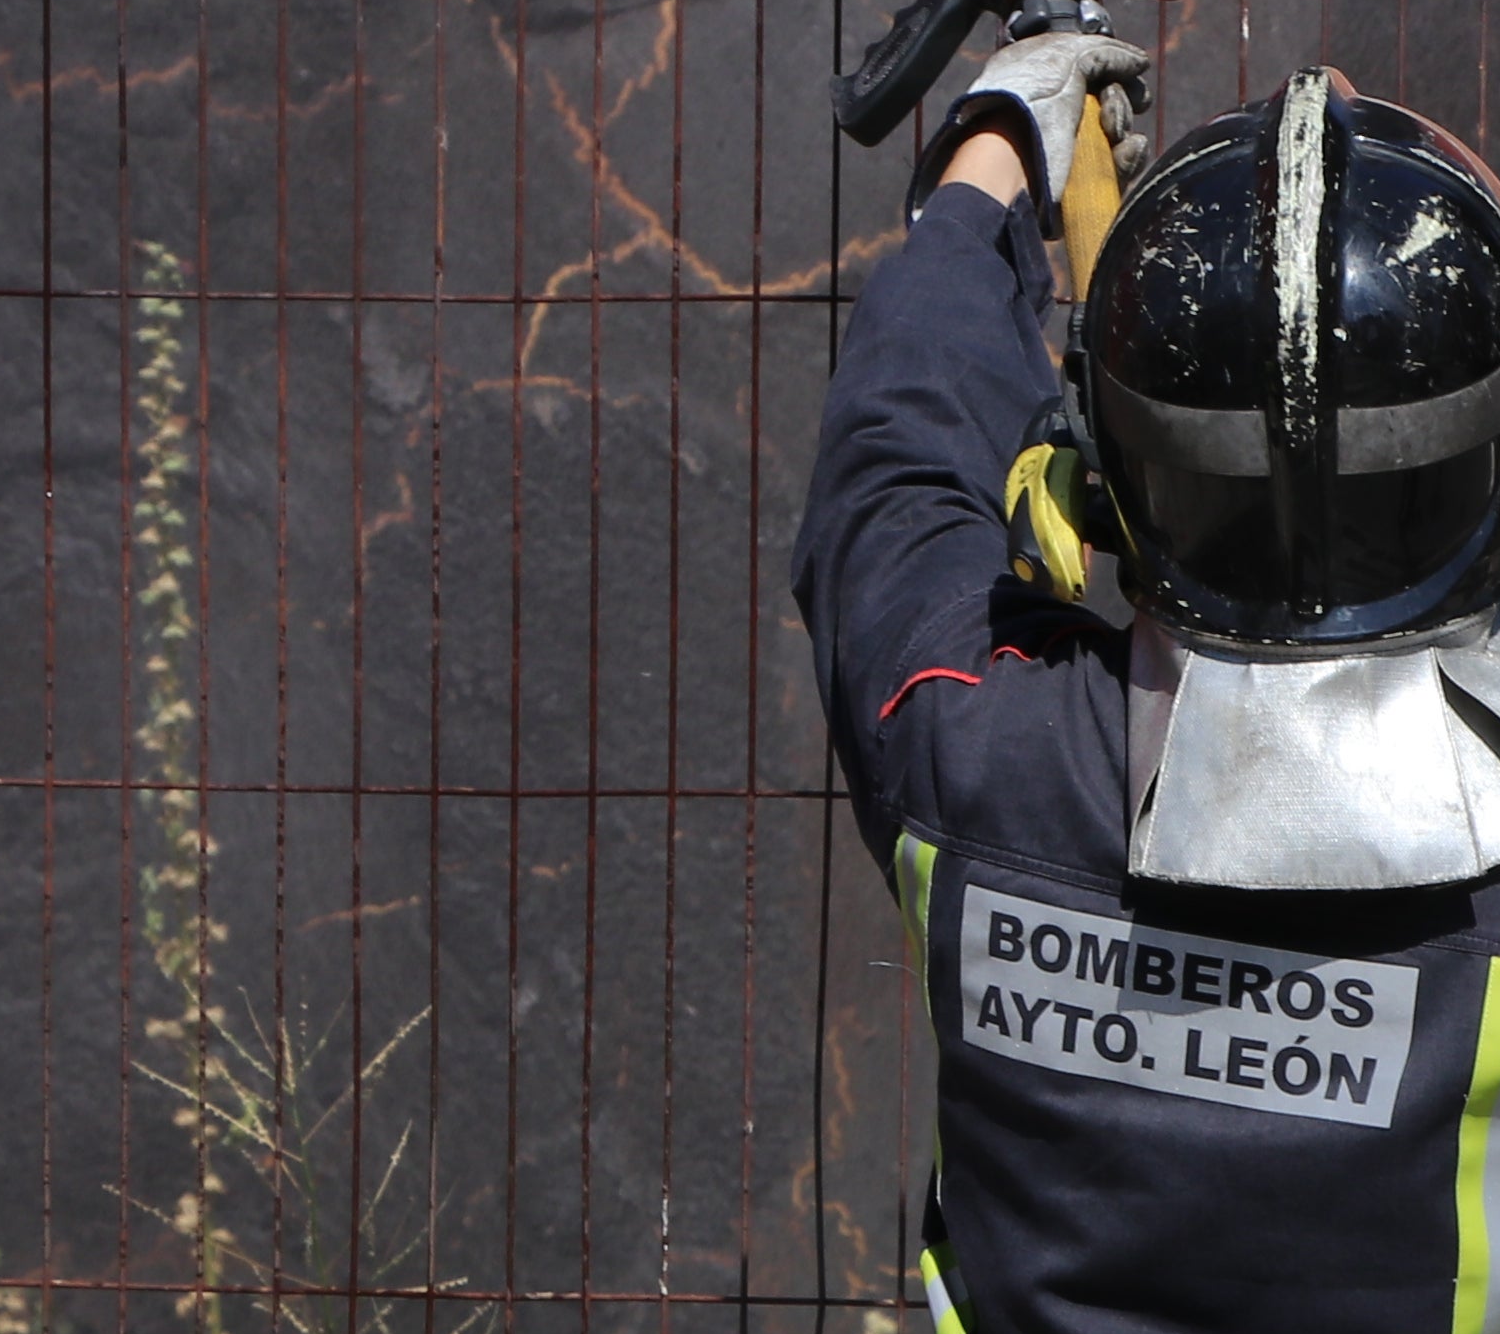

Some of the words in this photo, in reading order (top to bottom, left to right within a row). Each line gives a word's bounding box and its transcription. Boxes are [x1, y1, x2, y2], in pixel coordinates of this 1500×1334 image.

[987, 910, 1375, 1028] BOMBEROS
[976, 985, 1156, 1070] AYTO.
[1183, 1028, 1377, 1106] LEÓN
